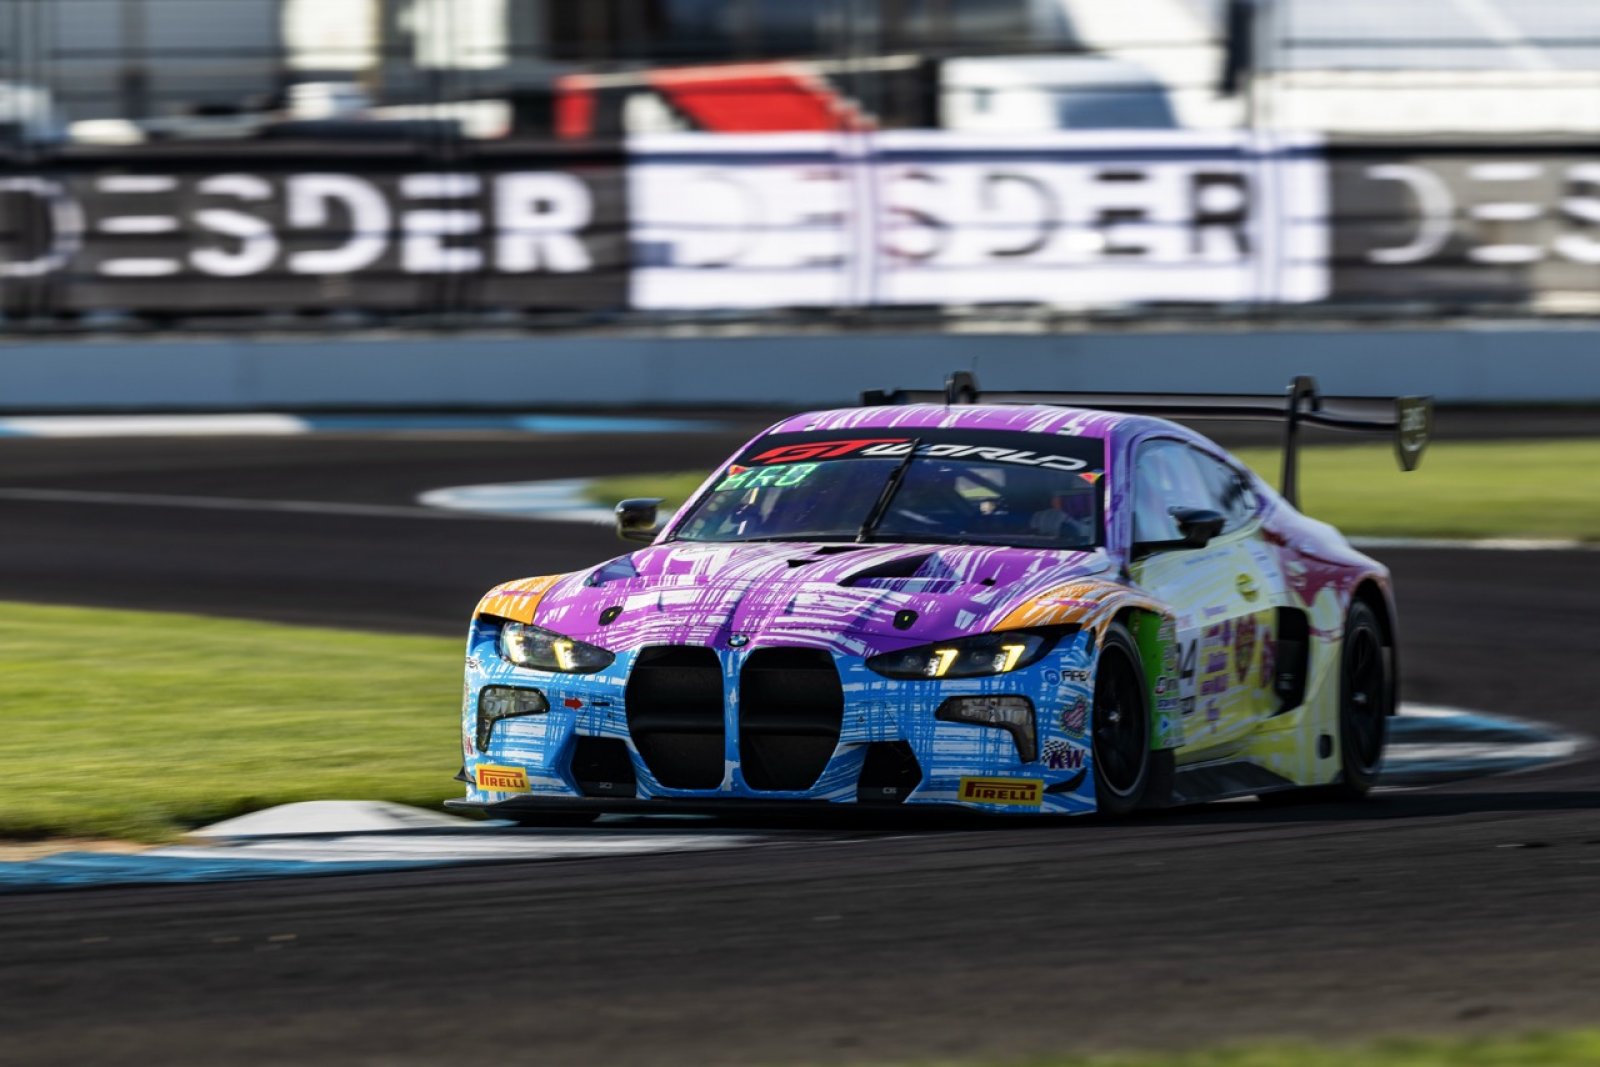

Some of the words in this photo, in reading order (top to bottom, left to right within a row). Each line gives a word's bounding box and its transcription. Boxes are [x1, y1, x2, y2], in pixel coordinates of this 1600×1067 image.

[0, 172, 594, 277] DESDER
[1048, 750, 1085, 769] KW
[479, 769, 526, 788] PIRELLI
[964, 781, 1038, 801] PIRELLI
